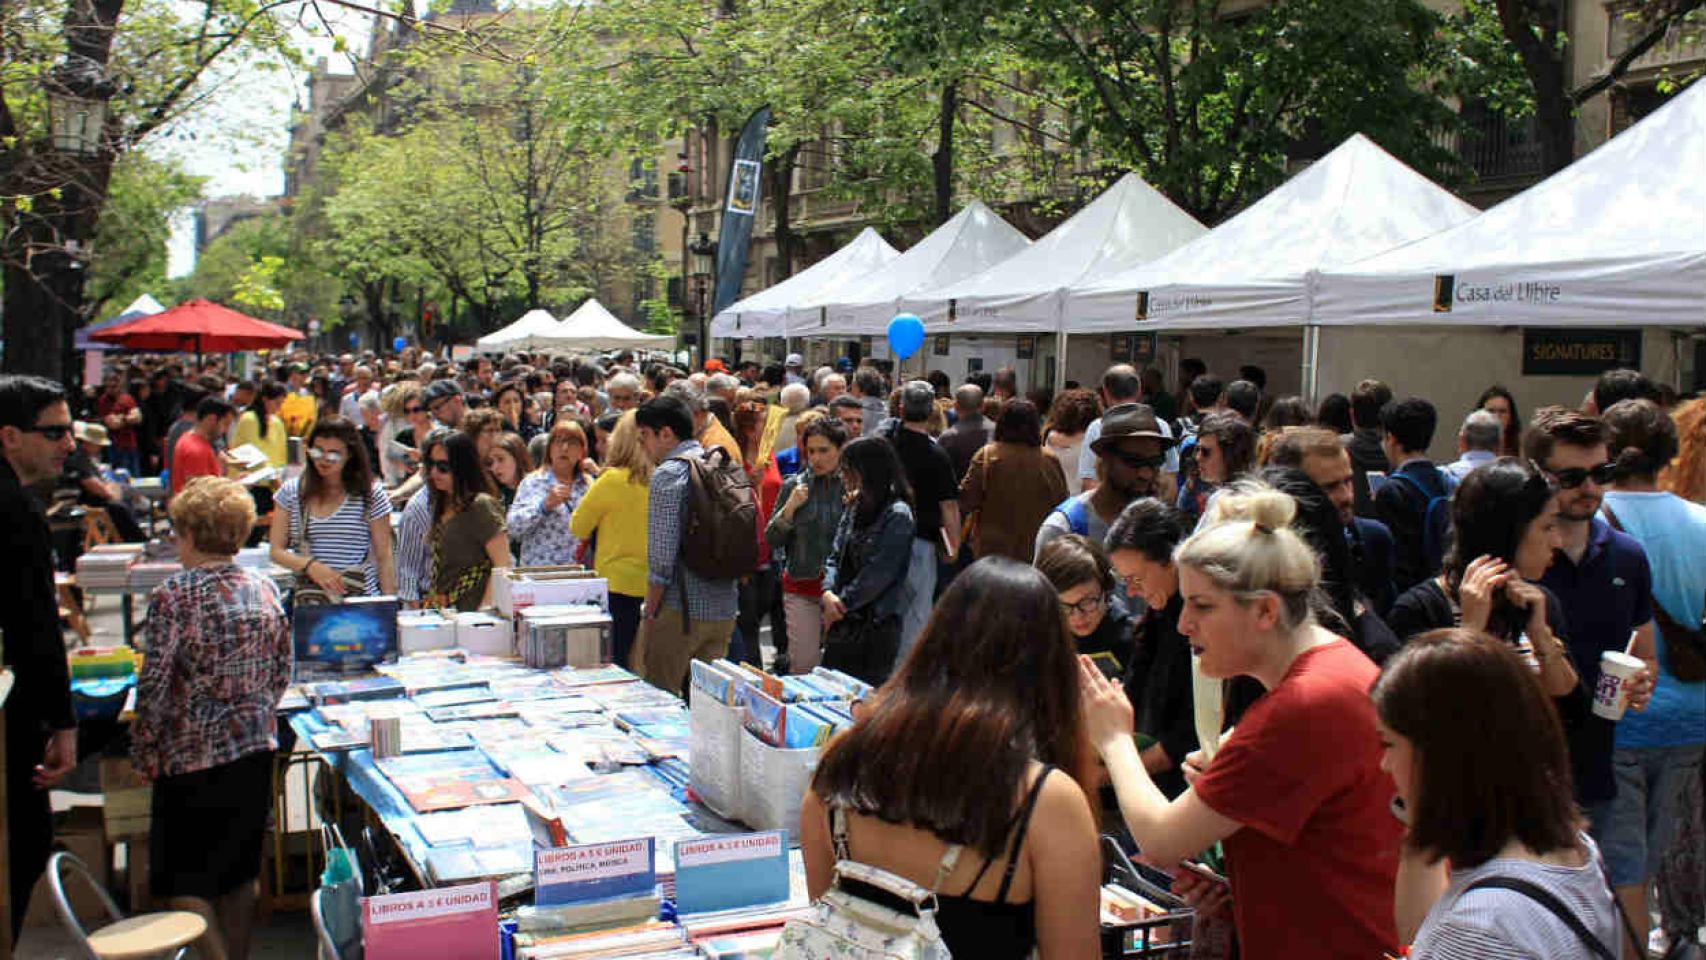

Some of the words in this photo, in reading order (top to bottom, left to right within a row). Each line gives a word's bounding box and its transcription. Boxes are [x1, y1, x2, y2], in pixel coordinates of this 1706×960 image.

[1455, 282, 1490, 303] Casa
[1494, 283, 1514, 302] del
[1517, 281, 1561, 303] Llibre
[1533, 342, 1617, 360] SIGNATURES
[742, 836, 779, 848] UNIDAD
[538, 851, 577, 863] LIBROS
[579, 850, 585, 858] A
[371, 901, 413, 916] LIBROS
[416, 900, 424, 909] A
[446, 892, 488, 906] UNIDAD
